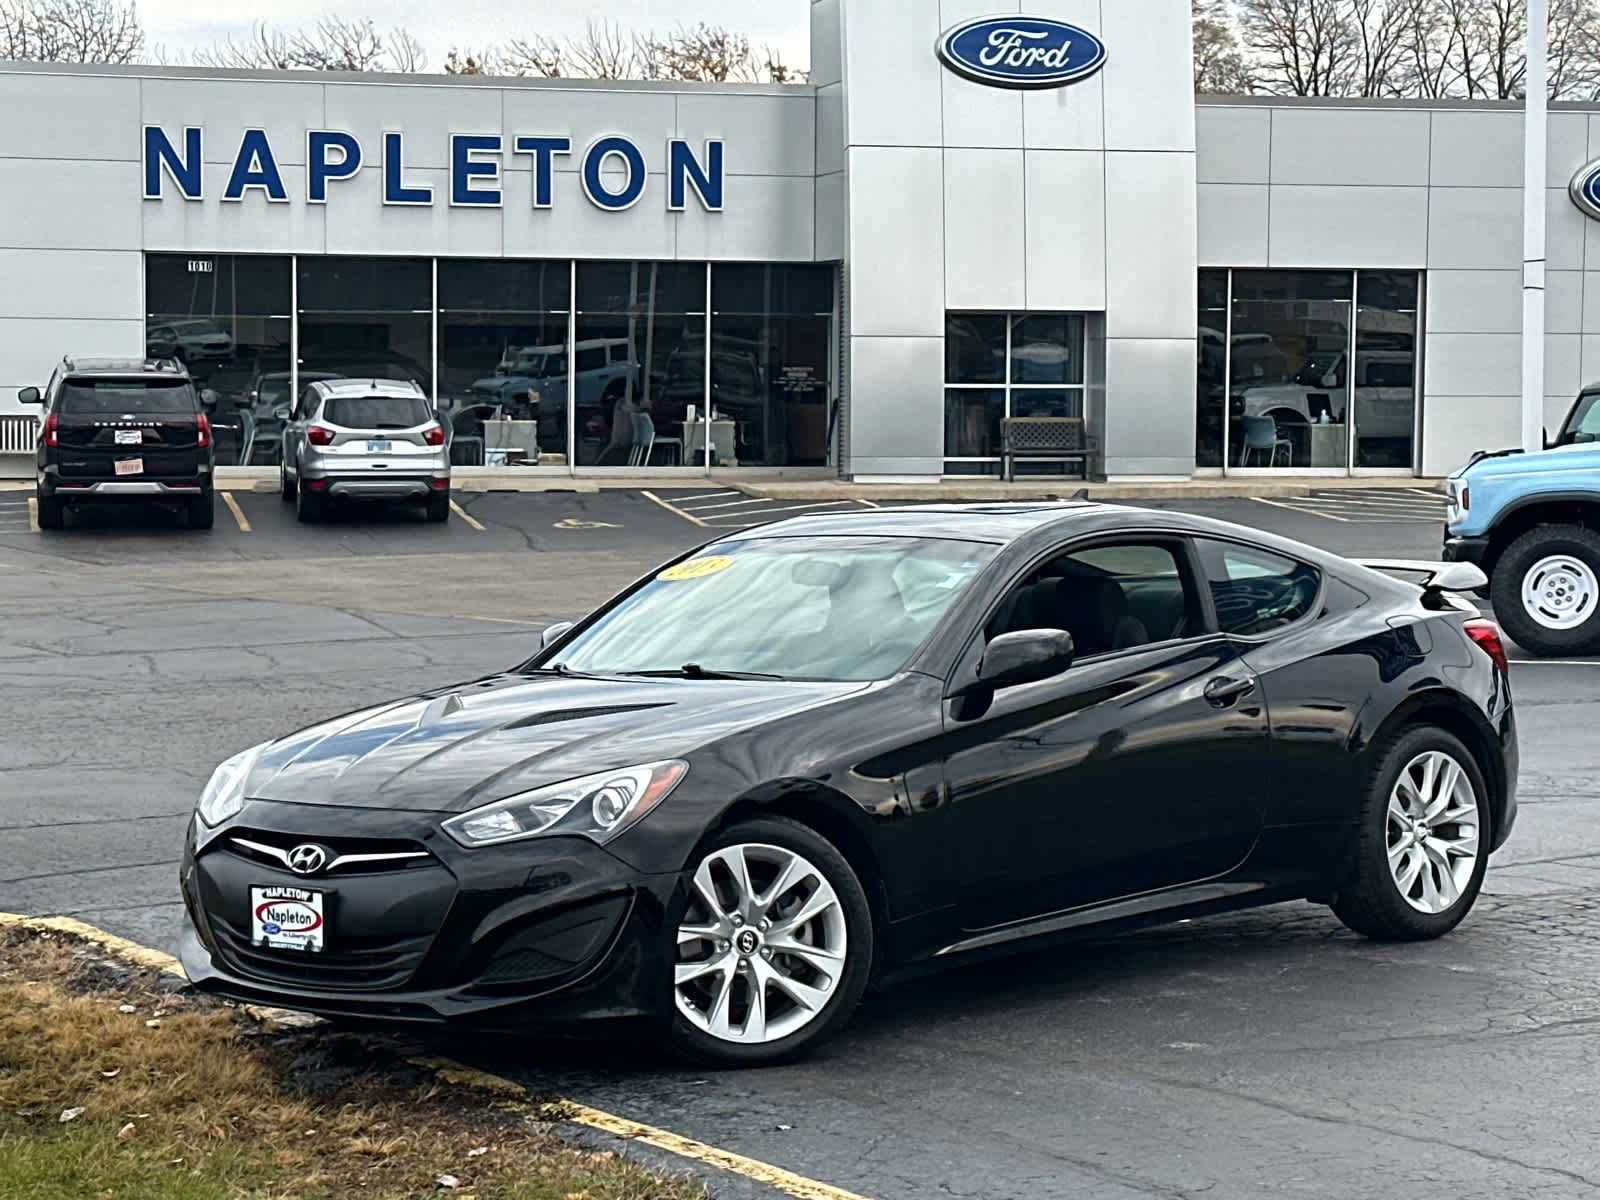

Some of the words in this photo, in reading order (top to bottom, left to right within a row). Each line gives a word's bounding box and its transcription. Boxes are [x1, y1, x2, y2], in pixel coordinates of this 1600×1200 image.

[979, 28, 1071, 68] Ford
[143, 125, 724, 212] NAPLETON
[266, 906, 312, 925] Napleton
